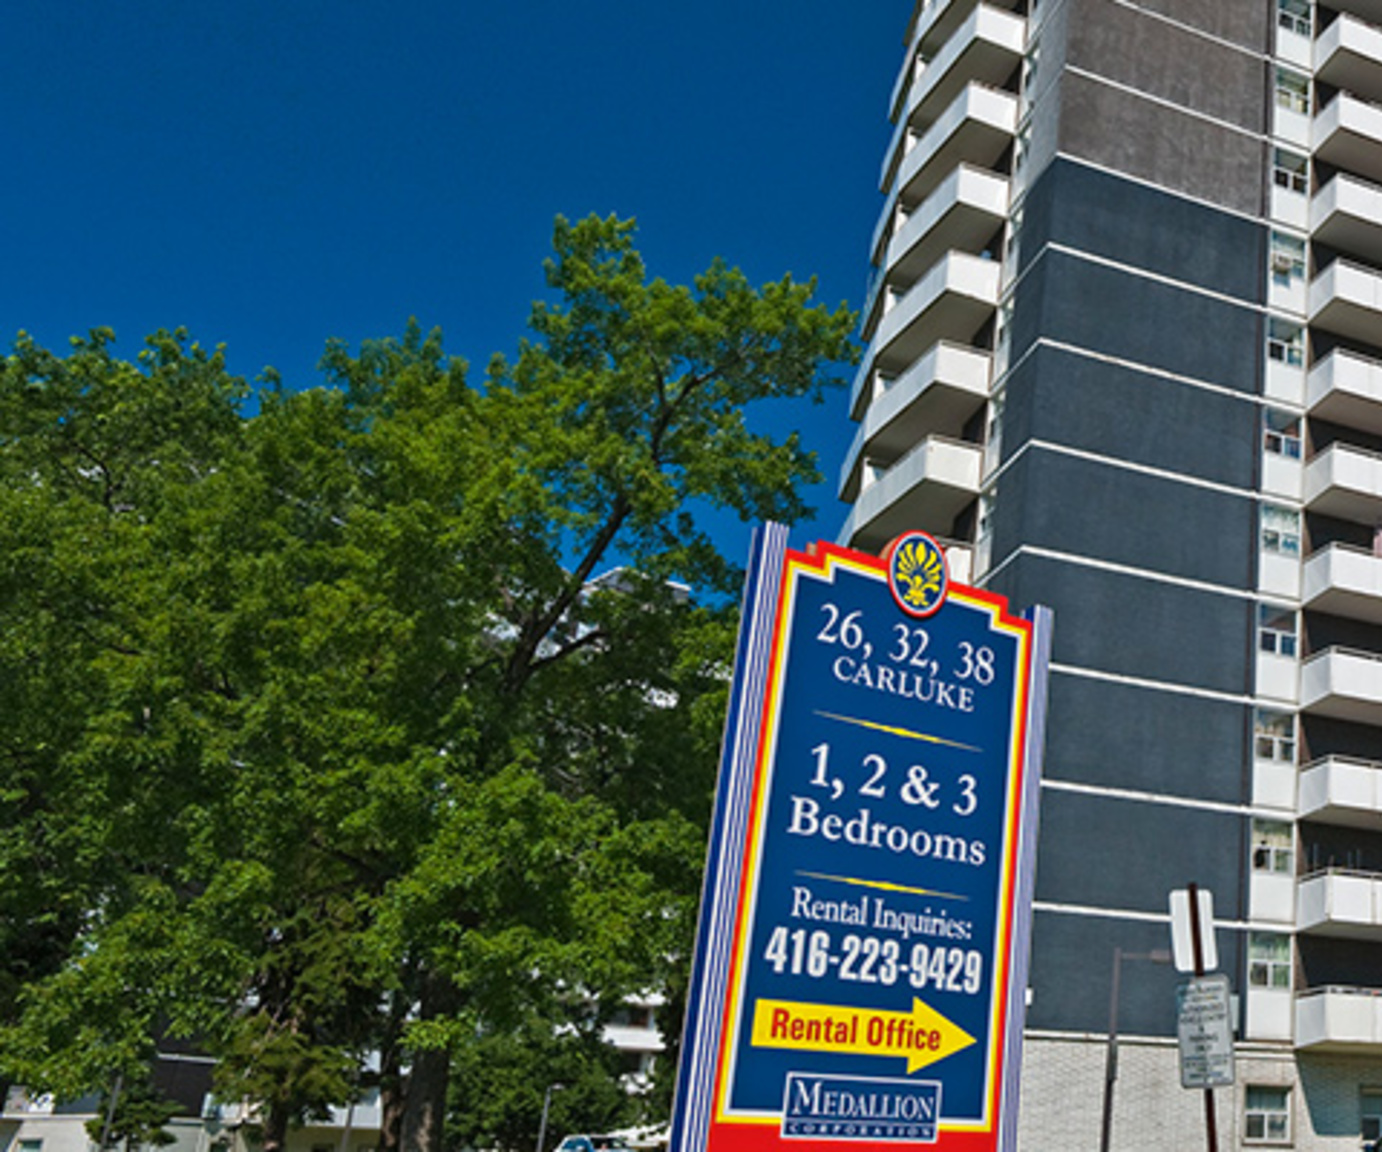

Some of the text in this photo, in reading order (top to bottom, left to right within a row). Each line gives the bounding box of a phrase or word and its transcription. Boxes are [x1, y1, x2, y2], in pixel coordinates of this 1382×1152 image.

[816, 603, 995, 685] 26, 32, 38
[833, 656, 974, 712] CARLUKE
[809, 742, 978, 816] 1, 2 & 3
[786, 794, 986, 867] Bedrooms
[791, 886, 972, 939] Rental Inquiries:
[764, 926, 982, 994] 416-223-9429
[770, 1008, 941, 1051] Rental Office
[791, 1079, 934, 1120] MEDALLION
[788, 1123, 931, 1136] CORPORATION
